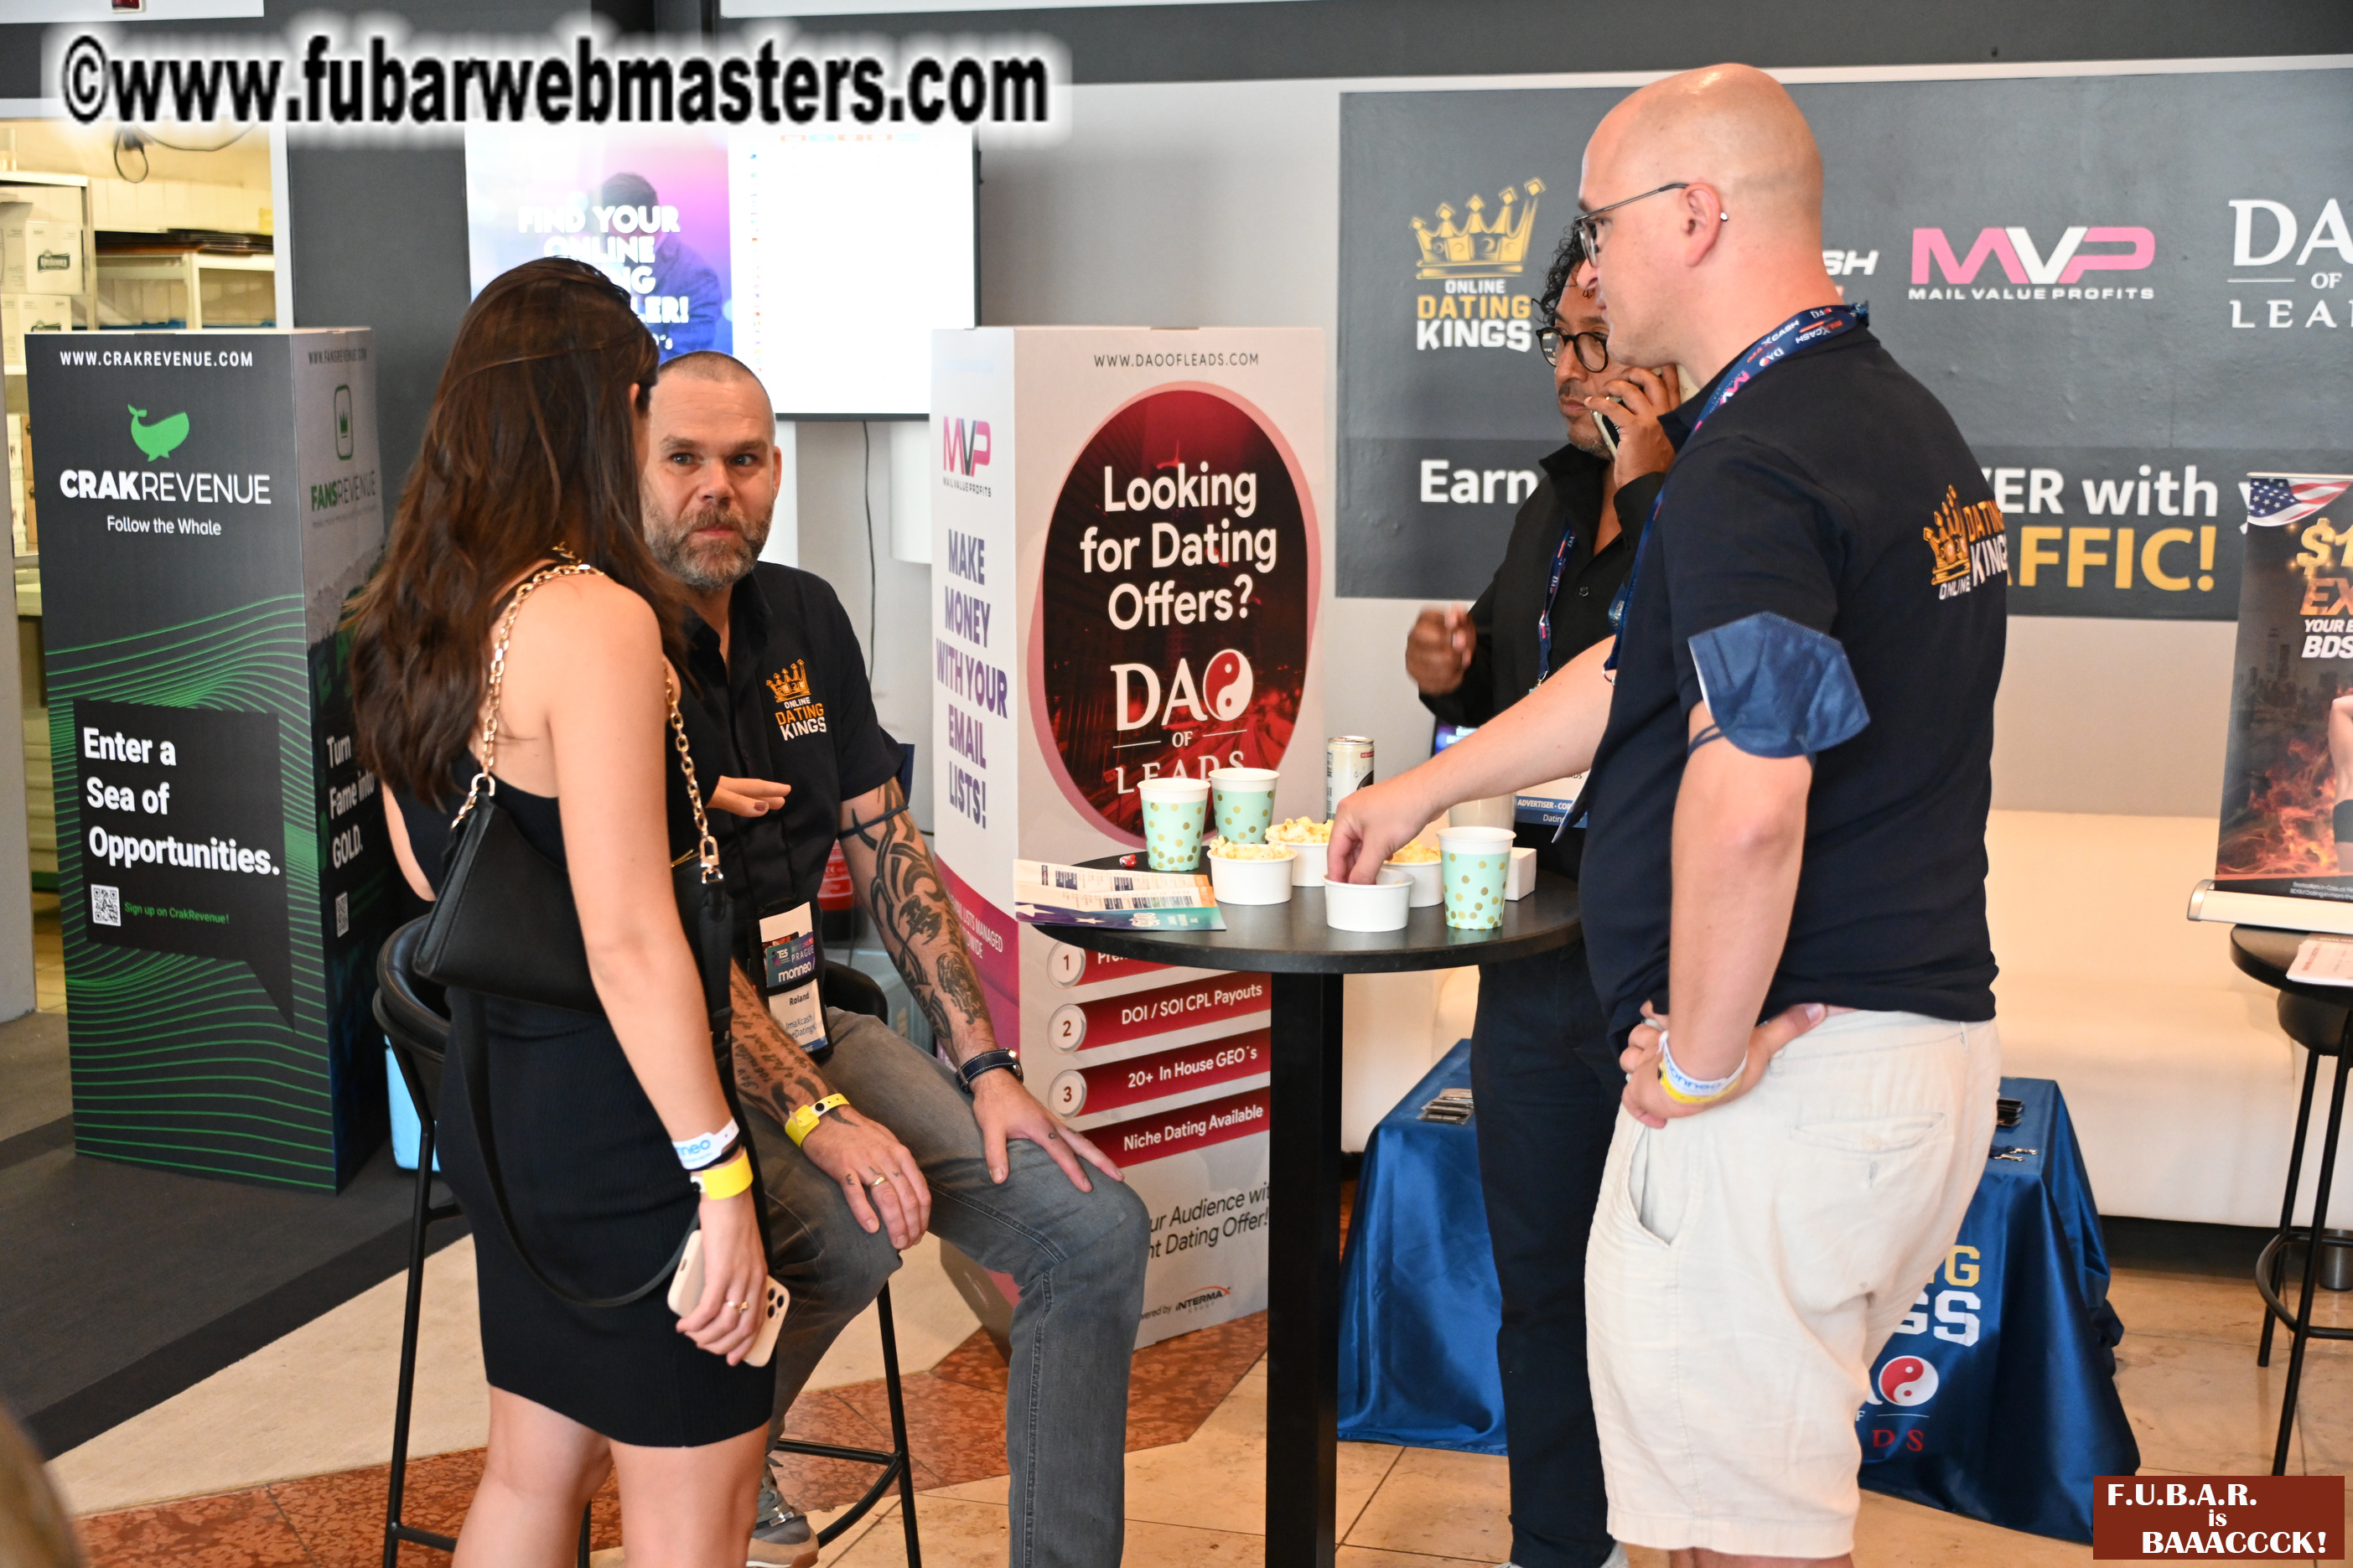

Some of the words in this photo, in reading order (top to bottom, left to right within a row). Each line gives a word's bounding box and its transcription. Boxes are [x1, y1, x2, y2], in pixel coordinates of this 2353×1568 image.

[518, 206, 586, 233] FIND
[592, 204, 680, 233] YOUR
[544, 235, 656, 263] ONLINE
[1911, 226, 2156, 284] MVP
[1444, 278, 1506, 294] ONLINE
[1909, 287, 1967, 300] MAIL
[1971, 287, 2045, 300] VALUE
[2052, 287, 2154, 300] PROFITS
[2311, 272, 2342, 289] OF
[1417, 295, 1531, 319] DATING
[1417, 318, 1532, 352] KINGS
[60, 350, 253, 367] WWW.CRAKREVENUE.COM
[1094, 353, 1259, 367] WWW.DAOOFLEADS.COM
[943, 416, 992, 478] MVP
[60, 469, 272, 505] CRAKREVENUE
[969, 484, 992, 498] PROFITS
[1104, 461, 1257, 518] Looking
[1420, 458, 1539, 503] Earn
[1982, 468, 2065, 514] ER
[2082, 464, 2218, 516] with
[106, 515, 150, 534] Follow
[153, 516, 174, 535] the
[178, 518, 222, 536] Whale
[948, 528, 985, 586] MAKE
[1080, 526, 1140, 573] for
[1152, 518, 1277, 573] Dating
[2007, 525, 2216, 591] FFIC!
[945, 585, 991, 648] MONEY
[1108, 574, 1254, 630] Offers?
[2304, 619, 2345, 633] YOUR
[935, 637, 963, 696] WITH
[965, 654, 1008, 719] YOUR
[775, 703, 825, 726] DATING
[784, 696, 811, 709] ONLINE
[780, 717, 827, 741] KINGS
[948, 703, 987, 770] EMAIL
[1172, 731, 1193, 748] OF
[83, 727, 153, 763] Enter
[160, 740, 177, 766] a
[326, 734, 352, 768] Turn
[86, 776, 135, 812] Sea
[143, 781, 169, 815] of
[329, 781, 357, 820] Fame
[358, 769, 376, 803] into
[949, 760, 987, 830] LISTS!
[1517, 799, 1554, 810] ADVERTISER
[89, 825, 281, 876] Opportunities.
[332, 824, 363, 870] GOLD.
[2305, 889, 2324, 898] Dating
[124, 901, 143, 917] Sign
[144, 905, 155, 919] up
[157, 908, 168, 918] on
[168, 907, 230, 924] CrakRevenue!
[976, 918, 1003, 953] MANAGED
[778, 949, 788, 959] TES
[790, 945, 815, 963] PRAGUE
[1063, 955, 1070, 970] 1
[779, 961, 811, 982] monneo
[790, 991, 810, 1006] Roland
[1063, 1020, 1071, 1037] 2
[1122, 1006, 1148, 1025] DOI
[1151, 1003, 1158, 1018] /
[1160, 998, 1184, 1017] SOI
[1186, 992, 1211, 1012] CPL
[1215, 984, 1262, 1006] Payouts
[1063, 1086, 1072, 1103] 3
[1128, 1070, 1153, 1089] 20+
[1159, 1066, 1171, 1081] In
[1174, 1055, 1214, 1078] House
[1124, 1131, 1162, 1151] Niche
[1164, 1120, 1206, 1141] Dating
[1209, 1104, 1263, 1130] Available
[1169, 1192, 1245, 1227] Audience
[1165, 1226, 1219, 1255] Dating
[1223, 1207, 1269, 1237] Offer!
